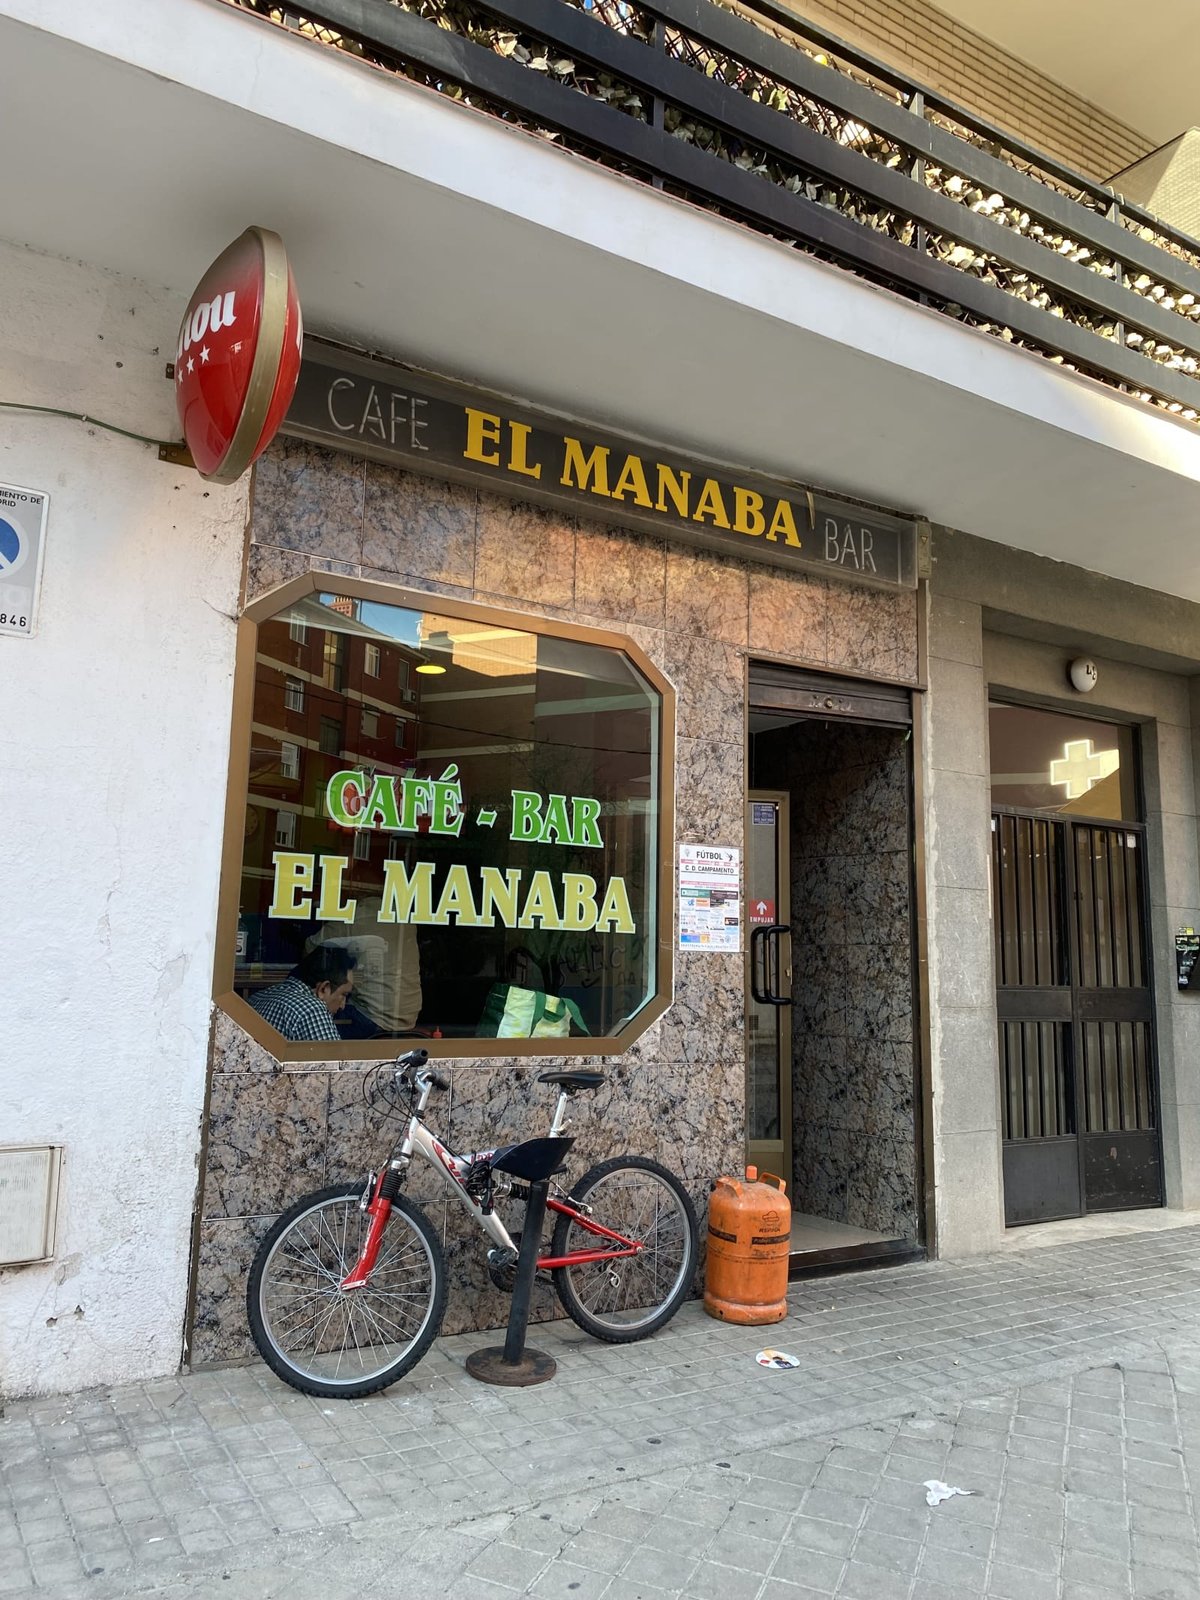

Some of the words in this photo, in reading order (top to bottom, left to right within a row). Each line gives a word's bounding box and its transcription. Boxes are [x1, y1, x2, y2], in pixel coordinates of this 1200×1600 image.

[328, 378, 429, 450] CAFE
[30, 496, 41, 505] DE
[463, 407, 541, 479] EL
[560, 437, 802, 548] MANABA
[824, 518, 877, 572] BAR
[326, 763, 464, 838] CAFÉ
[510, 790, 604, 848] BAR
[696, 850, 723, 860] FÚTBOL
[697, 866, 735, 874] CAMPAMENTO
[268, 851, 357, 924] EL
[377, 859, 636, 934] MANABA
